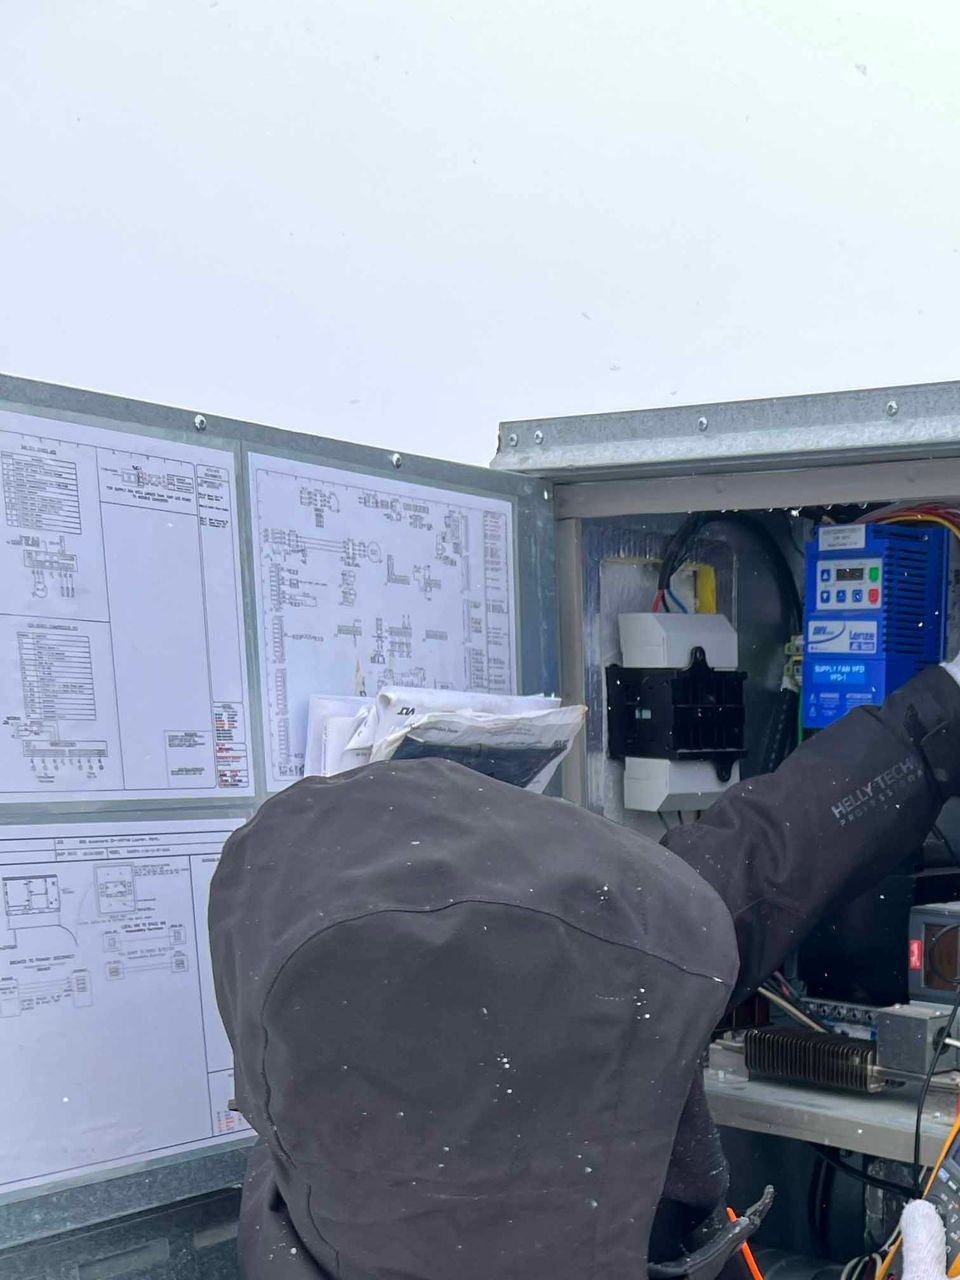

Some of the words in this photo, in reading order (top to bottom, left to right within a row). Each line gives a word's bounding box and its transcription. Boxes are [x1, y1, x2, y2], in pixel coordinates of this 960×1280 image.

[814, 665, 836, 673] SUPPLY
[837, 665, 851, 673] FAN
[831, 782, 873, 818] HELLY
[874, 758, 914, 788] TECH
